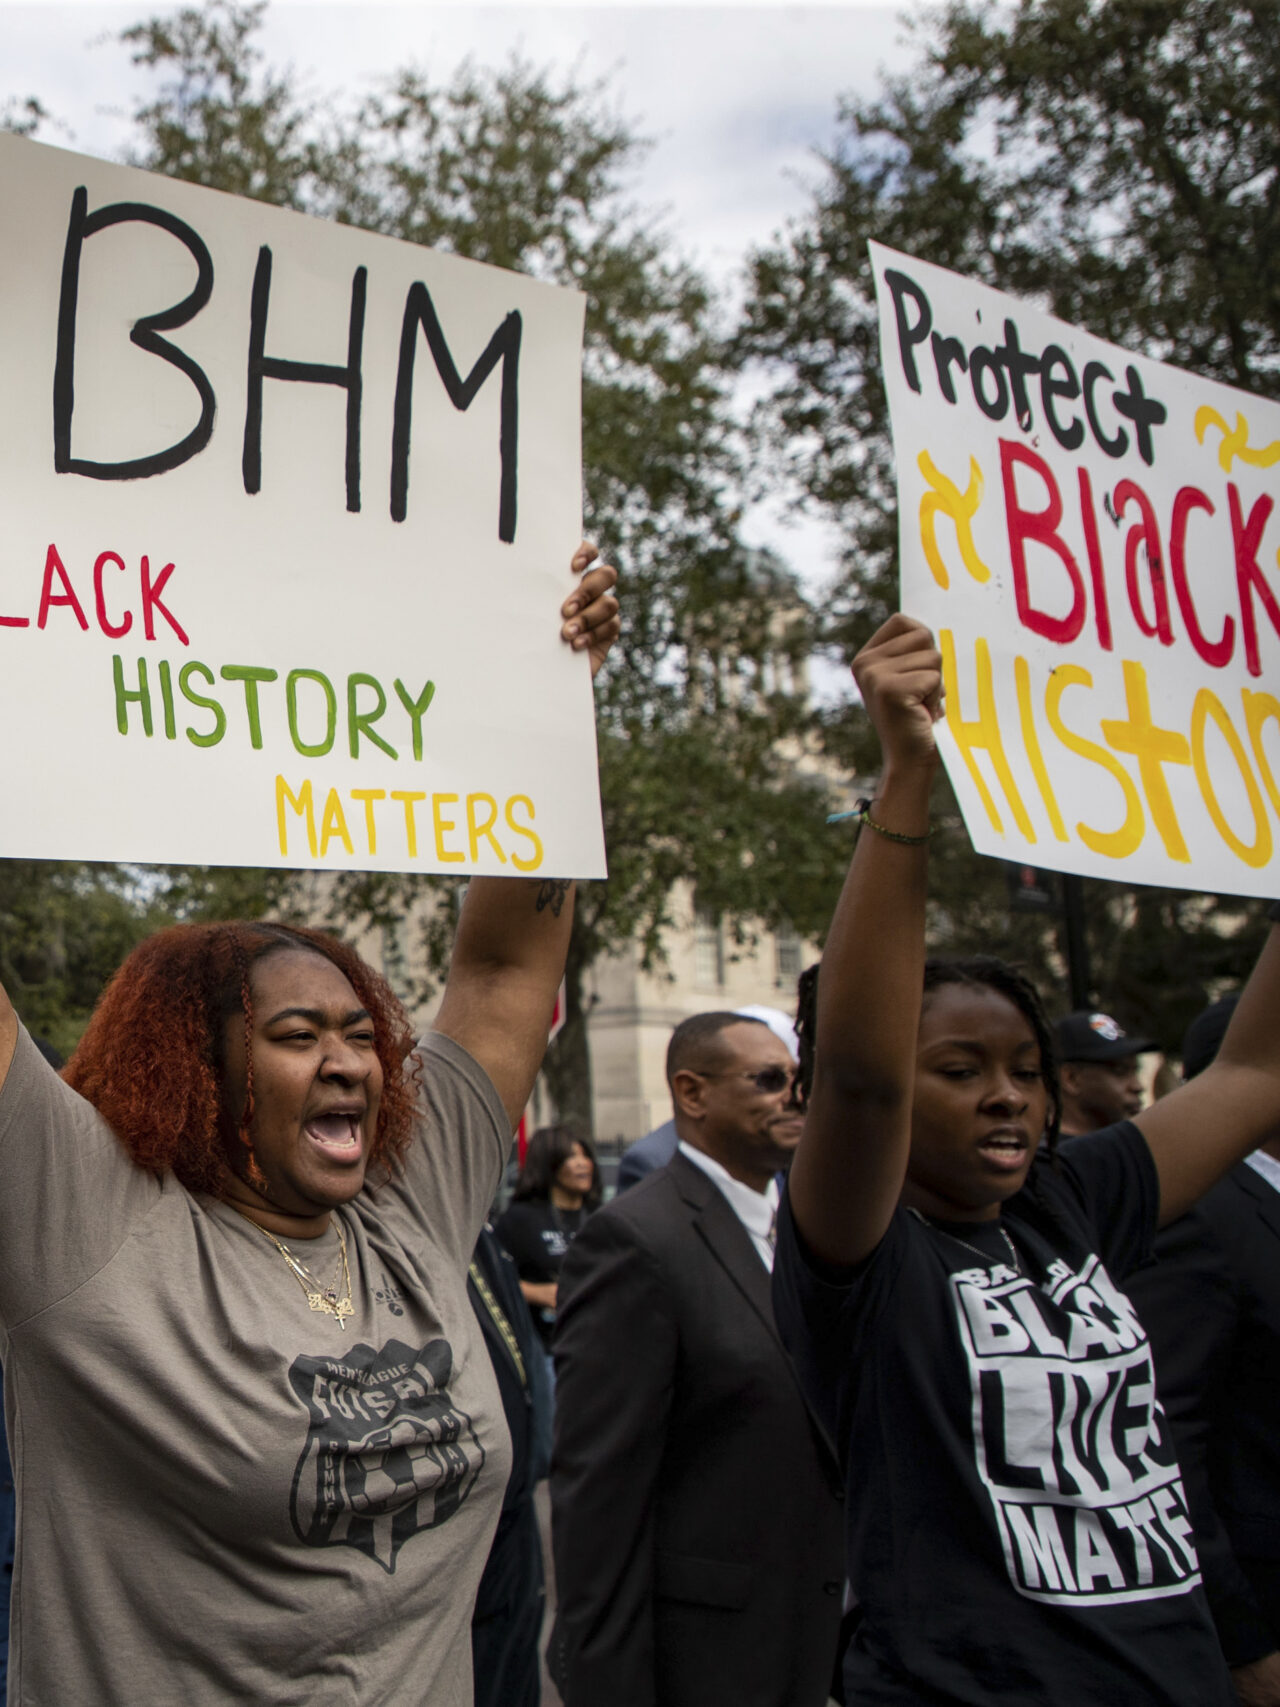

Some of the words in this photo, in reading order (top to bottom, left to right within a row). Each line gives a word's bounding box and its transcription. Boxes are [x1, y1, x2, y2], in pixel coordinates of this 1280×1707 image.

[51, 185, 522, 544] BHM
[884, 268, 1167, 467] Protect
[112, 653, 436, 762] HISTORY
[274, 773, 545, 873] MATTERS
[959, 1254, 1148, 1361] BLACK
[362, 1363, 411, 1387] LAGUE
[1003, 1480, 1201, 1593] MATTE
